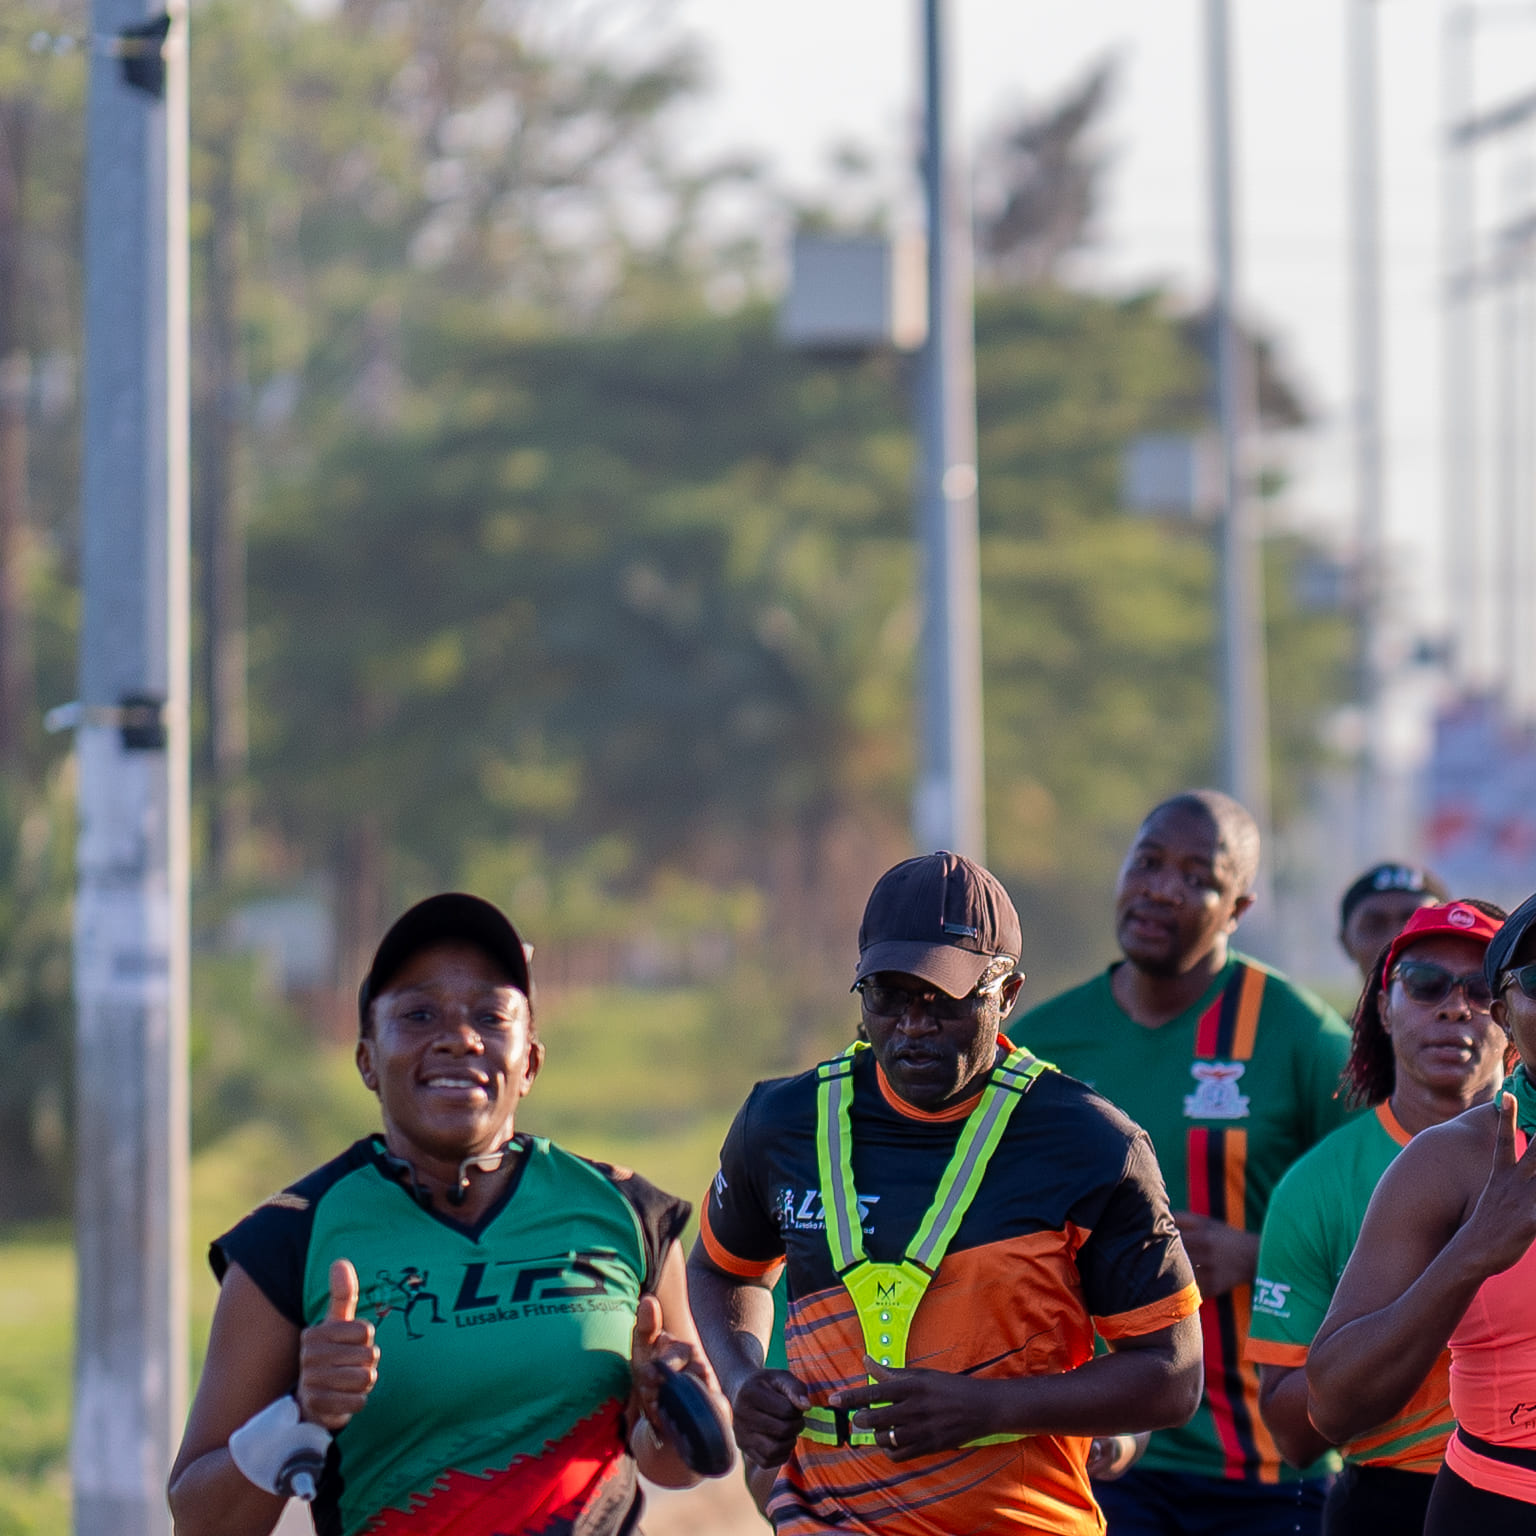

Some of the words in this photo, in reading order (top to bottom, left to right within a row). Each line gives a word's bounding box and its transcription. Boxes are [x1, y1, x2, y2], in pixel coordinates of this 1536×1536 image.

[453, 1251, 617, 1311] LFS
[1254, 1278, 1291, 1309] FS
[455, 1307, 519, 1328] Lusaka
[523, 1300, 584, 1317] Fitness
